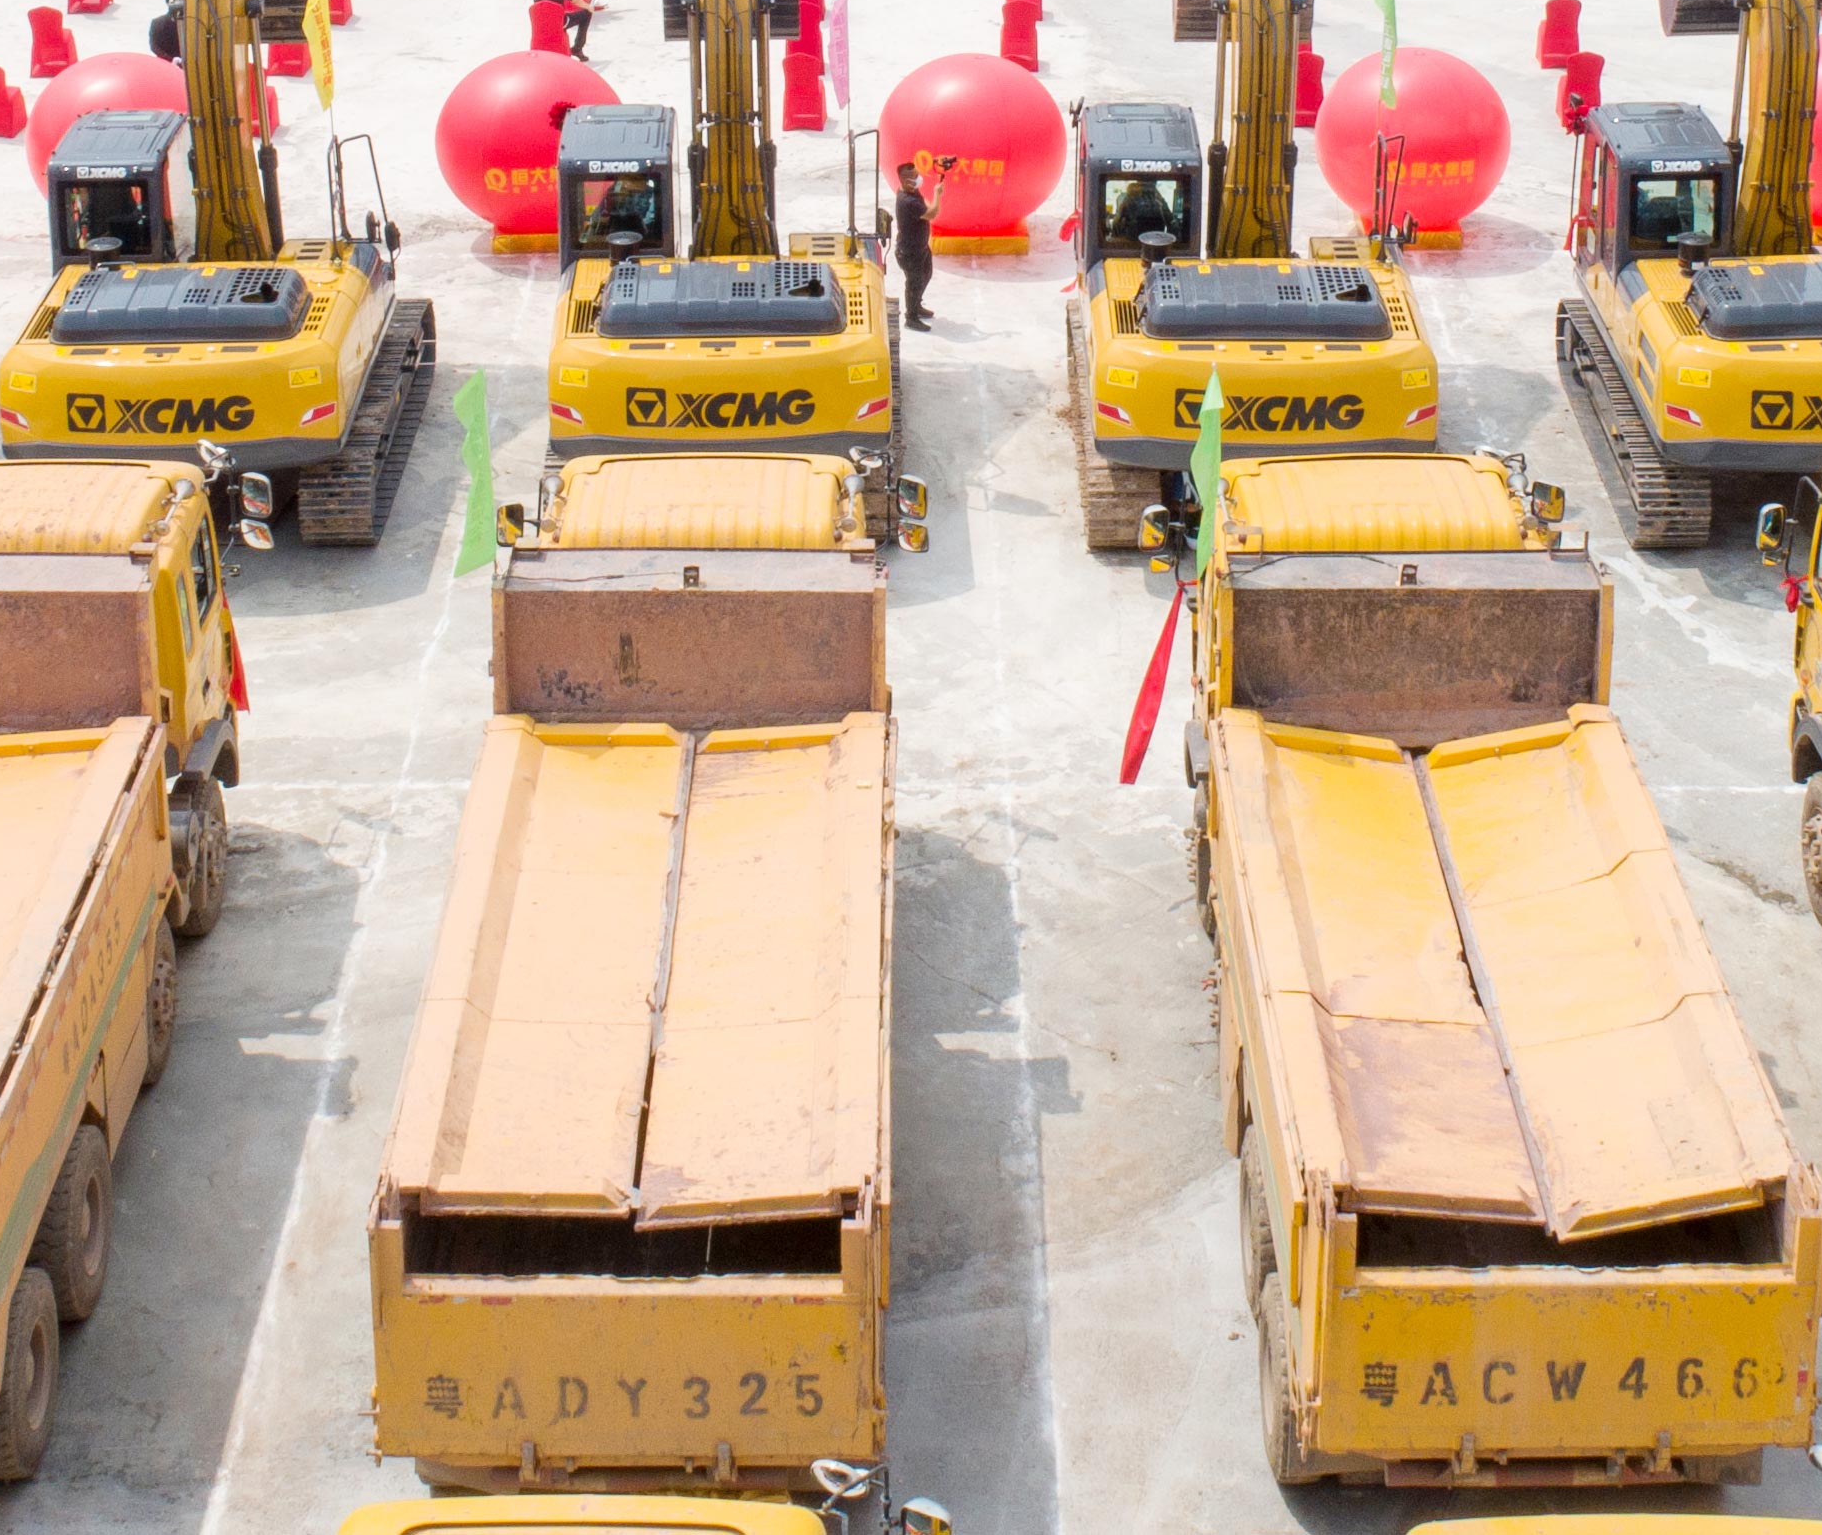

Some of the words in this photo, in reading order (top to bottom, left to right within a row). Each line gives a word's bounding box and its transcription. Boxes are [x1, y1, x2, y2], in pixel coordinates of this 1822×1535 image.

[90, 167, 127, 179] XCMG
[601, 161, 640, 173] XCMG
[1136, 161, 1172, 172] XCMG
[1410, 160, 1476, 179] 恒大集团
[1664, 160, 1702, 171] XCMG
[107, 395, 256, 434] XCMG
[667, 389, 816, 429] XCMG
[1221, 394, 1365, 432] XCMG
[427, 1373, 824, 1421] 粤ADY325
[1359, 1358, 1761, 1409] 粤ACW466
